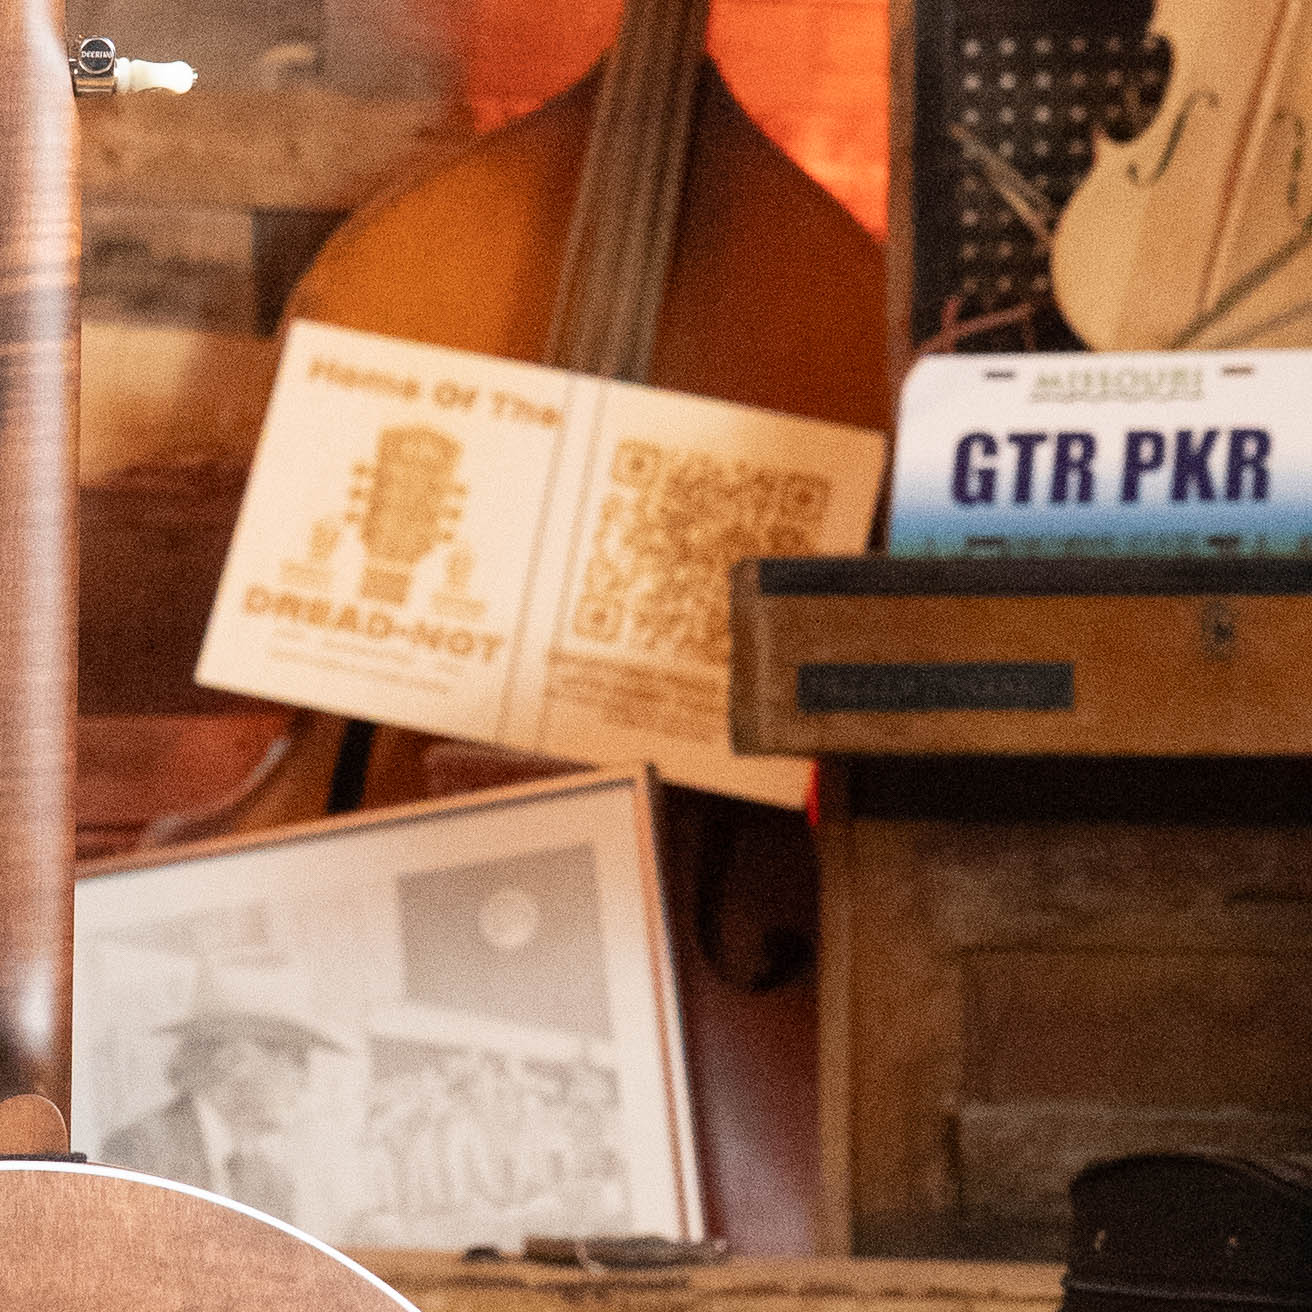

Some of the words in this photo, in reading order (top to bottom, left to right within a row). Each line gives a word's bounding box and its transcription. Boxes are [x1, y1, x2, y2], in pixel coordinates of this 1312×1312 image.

[309, 356, 421, 400] Home
[435, 381, 477, 413] Of
[492, 389, 564, 430] The
[952, 430, 1098, 506] GTR
[1120, 427, 1273, 504] PKR
[243, 584, 506, 665] DREAD-NOT
